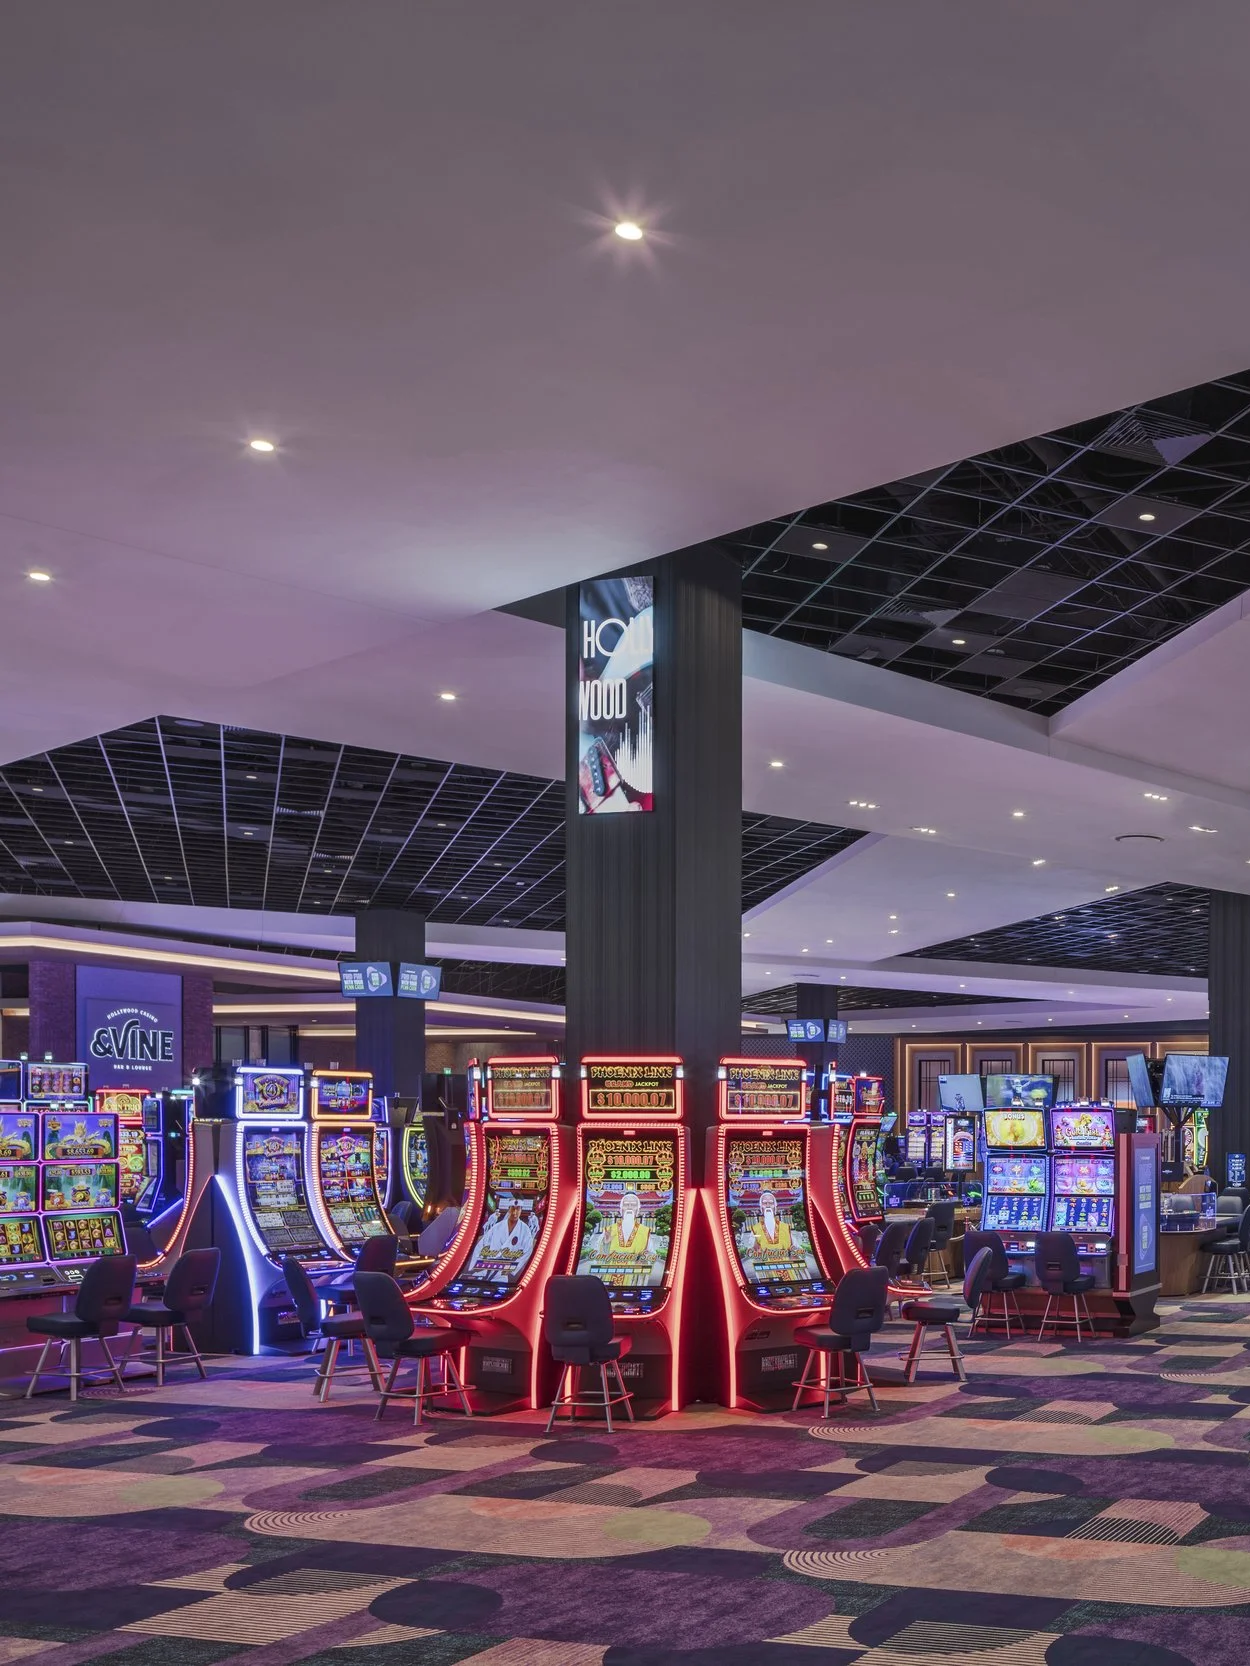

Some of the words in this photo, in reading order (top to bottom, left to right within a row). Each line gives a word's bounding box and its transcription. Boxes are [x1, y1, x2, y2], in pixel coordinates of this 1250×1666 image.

[107, 1007, 138, 1020] HOLLYWOOD
[140, 1010, 158, 1023] CASINO
[90, 1018, 174, 1062] &VINE
[591, 1066, 643, 1078] PHOENIX
[644, 1066, 674, 1078] LINK
[729, 1068, 774, 1080] PHOENIX
[775, 1069, 800, 1080] LINK
[605, 1080, 634, 1088] GRAND
[588, 1141, 641, 1153] PHOENIX
[642, 1141, 673, 1153] LINK
[731, 1141, 776, 1152] PHOENIX
[777, 1141, 802, 1152] LINK
